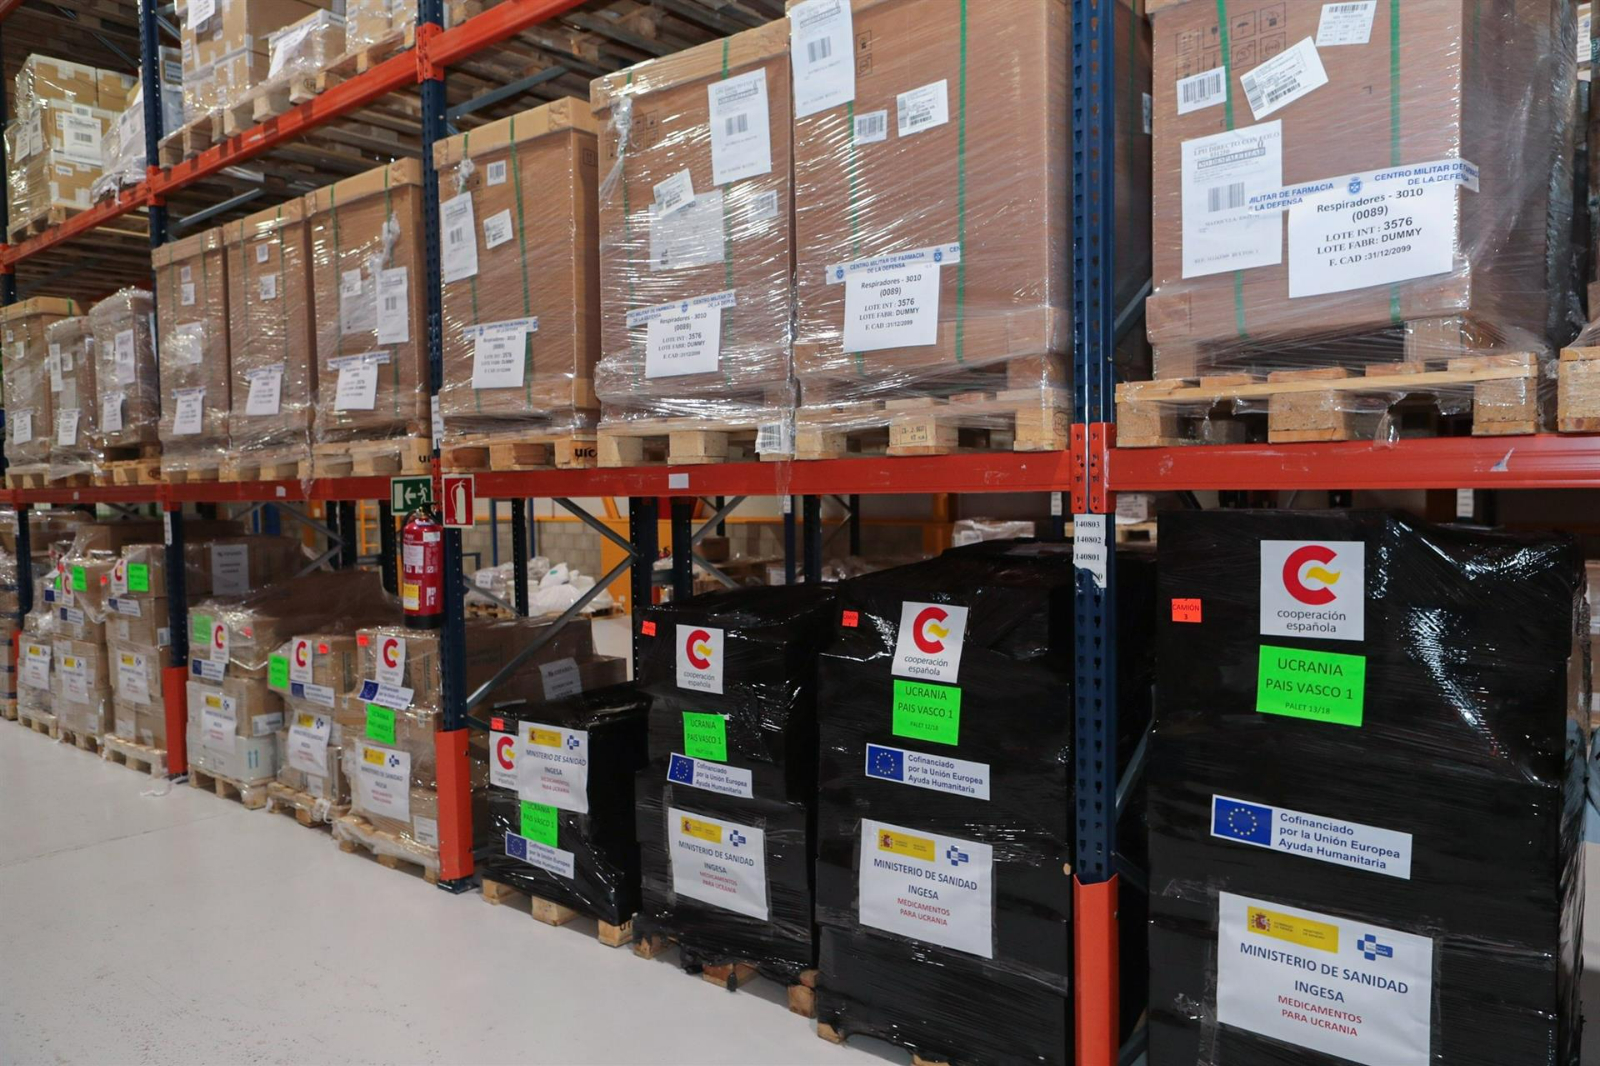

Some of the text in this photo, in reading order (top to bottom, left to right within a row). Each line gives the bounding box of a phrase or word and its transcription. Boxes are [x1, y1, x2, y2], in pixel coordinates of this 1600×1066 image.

[1374, 170, 1411, 182] CENTRO
[1414, 164, 1450, 176] MILITAR
[1408, 178, 1419, 186] DE
[1279, 190, 1290, 198] DE
[1292, 183, 1334, 196] FARMACIA
[1254, 198, 1303, 212] LA DEFENSA
[1317, 194, 1386, 213] Respiradores
[1396, 188, 1424, 199] 3010
[1352, 206, 1388, 223] (0089)
[1326, 231, 1355, 242] LOTE
[1358, 226, 1376, 237] INT
[1384, 216, 1412, 231] 3576
[1317, 228, 1422, 254] LOTE FABR: DUMMY
[850, 262, 869, 270] CENTRO
[898, 252, 924, 262] FARMACIA
[1329, 258, 1338, 266] F.
[1340, 254, 1362, 266] CAD
[861, 278, 900, 289] Respiradores
[906, 274, 922, 282] 3010
[880, 287, 902, 298] (0089)
[864, 304, 880, 312] LOTE
[898, 298, 914, 308] 3576
[660, 316, 690, 324] Respiradores
[859, 312, 875, 320] LOTE
[896, 308, 920, 316] DUMMY
[689, 332, 702, 340] 3576
[687, 340, 705, 348] DUMMY
[1277, 608, 1346, 624] cooperación
[1286, 620, 1337, 634] española
[904, 654, 948, 668] cooperación
[1277, 658, 1343, 677] UCRANIA
[683, 671, 715, 681] cooperación
[908, 665, 940, 676] española
[688, 680, 711, 689] española
[1266, 678, 1353, 699] PAIS VASCO 1
[905, 686, 947, 700] UCRANIA
[898, 703, 953, 719] PAIS VASCO 1
[1285, 702, 1331, 715] PALET 13/18
[690, 719, 716, 729] UCRANIA
[526, 749, 553, 760] MINISTERIO
[562, 756, 586, 766] SANIDAD
[908, 755, 954, 769] Cofinanciado
[696, 762, 727, 774] Cofinanciado
[908, 765, 983, 785] por la Unión Europea
[696, 779, 742, 794] Ayuda Humanitaria
[725, 777, 747, 787] Europea
[908, 775, 975, 794] Ayuda Humanitaria
[1280, 813, 1354, 836] Cofinanciado
[1279, 826, 1400, 861] por la Unión Europea
[679, 840, 754, 866] MINISTERIO DE SANIDAD
[1278, 839, 1387, 869] Ayuda Humanitaria
[704, 862, 727, 874] INGESA
[874, 858, 977, 891] MINISTERIO DE SANIDAD
[908, 885, 939, 900] INGESA
[897, 898, 950, 916] MEDICAMENTOS
[900, 908, 948, 926] PARA UCRANIA
[1240, 942, 1409, 994] MINISTERIO DE SANIDAD
[1294, 980, 1344, 1003] INGESA
[1278, 995, 1362, 1024] MEDICAMENTOS
[1282, 1008, 1358, 1036] PARA UCRANIA
